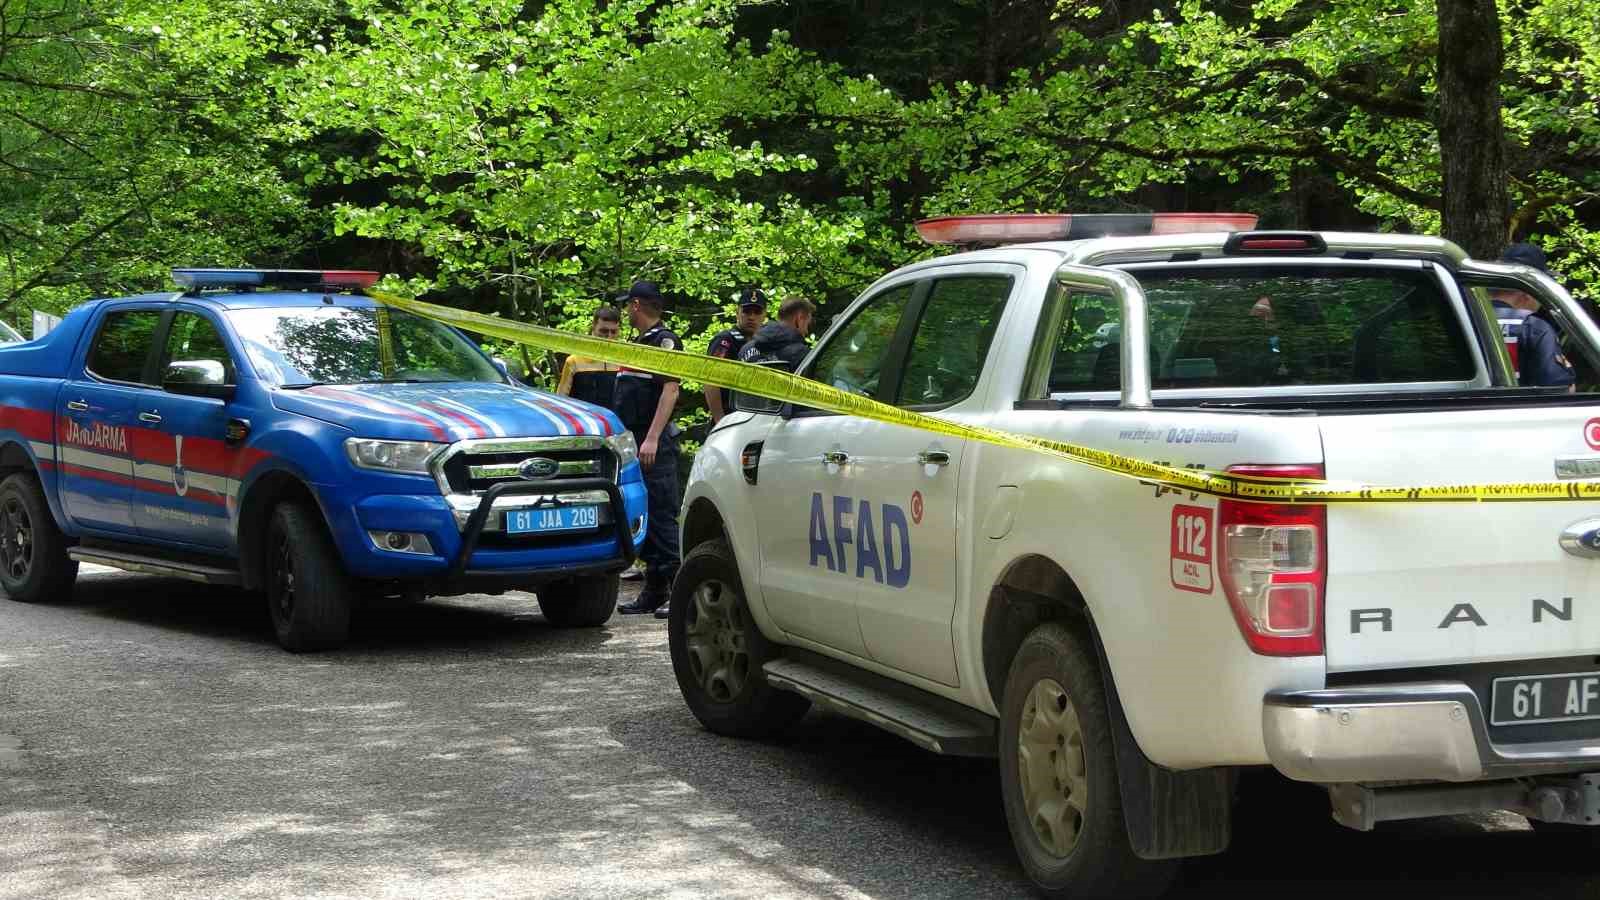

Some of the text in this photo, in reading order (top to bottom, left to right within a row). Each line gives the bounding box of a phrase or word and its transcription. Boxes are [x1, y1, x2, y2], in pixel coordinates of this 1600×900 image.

[516, 506, 596, 529] 61 JAA 209
[1177, 514, 1206, 557] 112
[809, 492, 911, 588] AFAD
[1350, 598, 1573, 634] RAN
[1512, 678, 1599, 718] 61 AF
